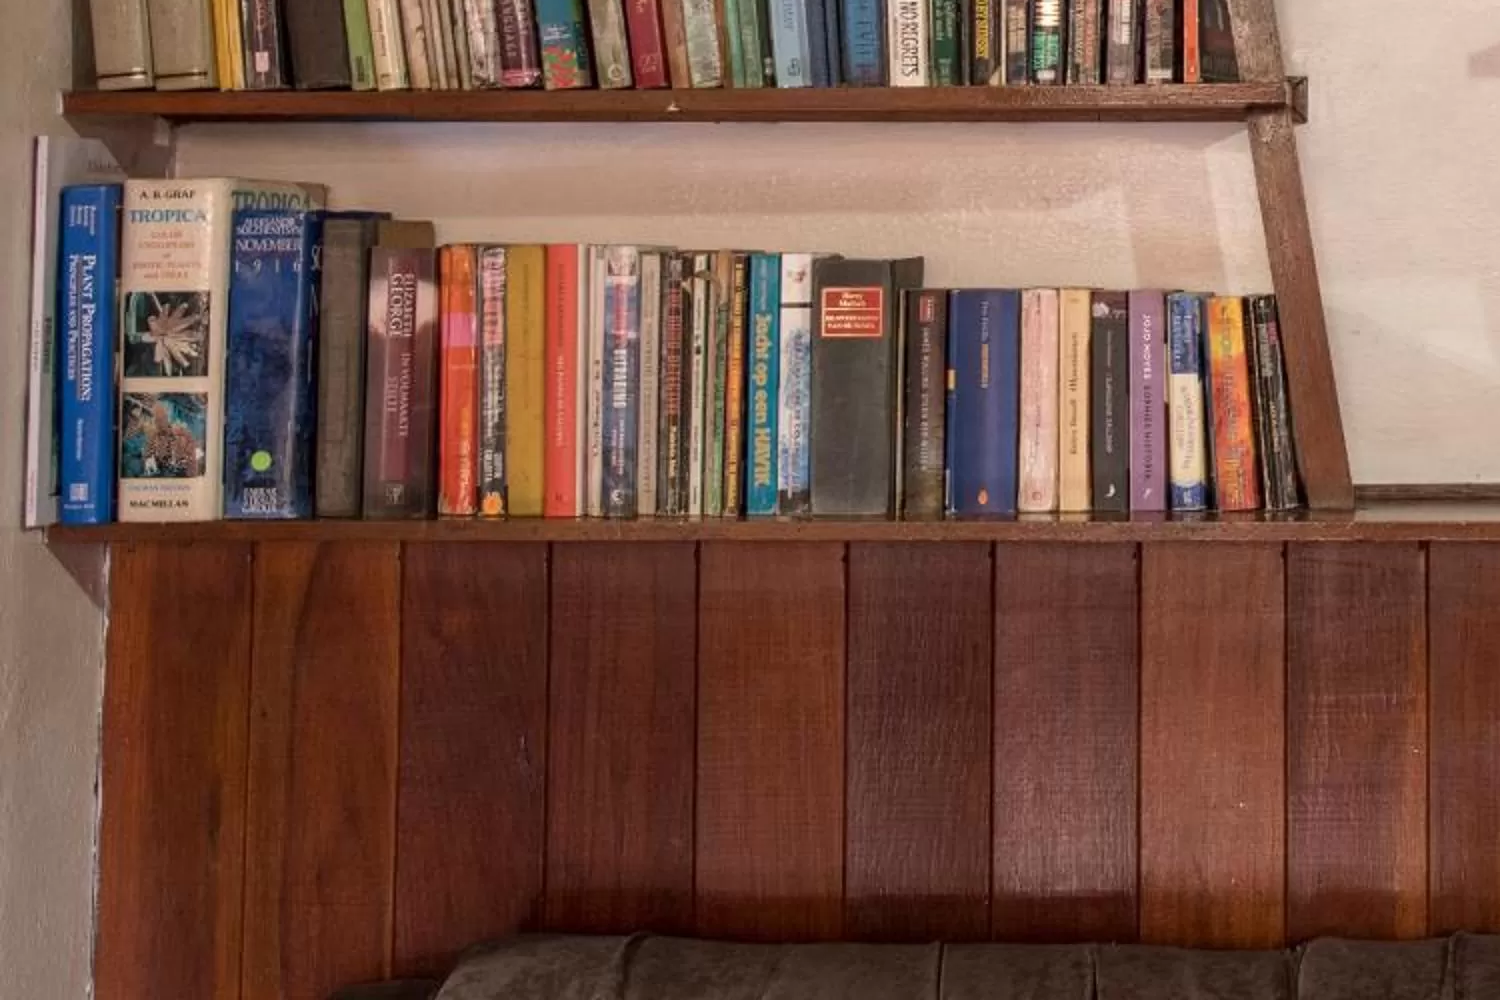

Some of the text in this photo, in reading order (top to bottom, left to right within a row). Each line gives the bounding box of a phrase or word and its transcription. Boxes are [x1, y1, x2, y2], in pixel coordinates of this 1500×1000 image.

[900, 1, 920, 78] NO REGRETS
[128, 208, 207, 225] TROPICA
[235, 238, 303, 252] NOVEMBER
[82, 254, 98, 297] PLANT
[389, 273, 403, 337] GEORGE
[402, 273, 415, 337] ELIZABETH
[67, 254, 80, 380] PRINCIPLES AND PRACTICES
[1142, 313, 1152, 379] JOJO MOYES
[80, 301, 97, 401] PROPAGATION:
[752, 313, 772, 488] Jacht op een HAVIK
